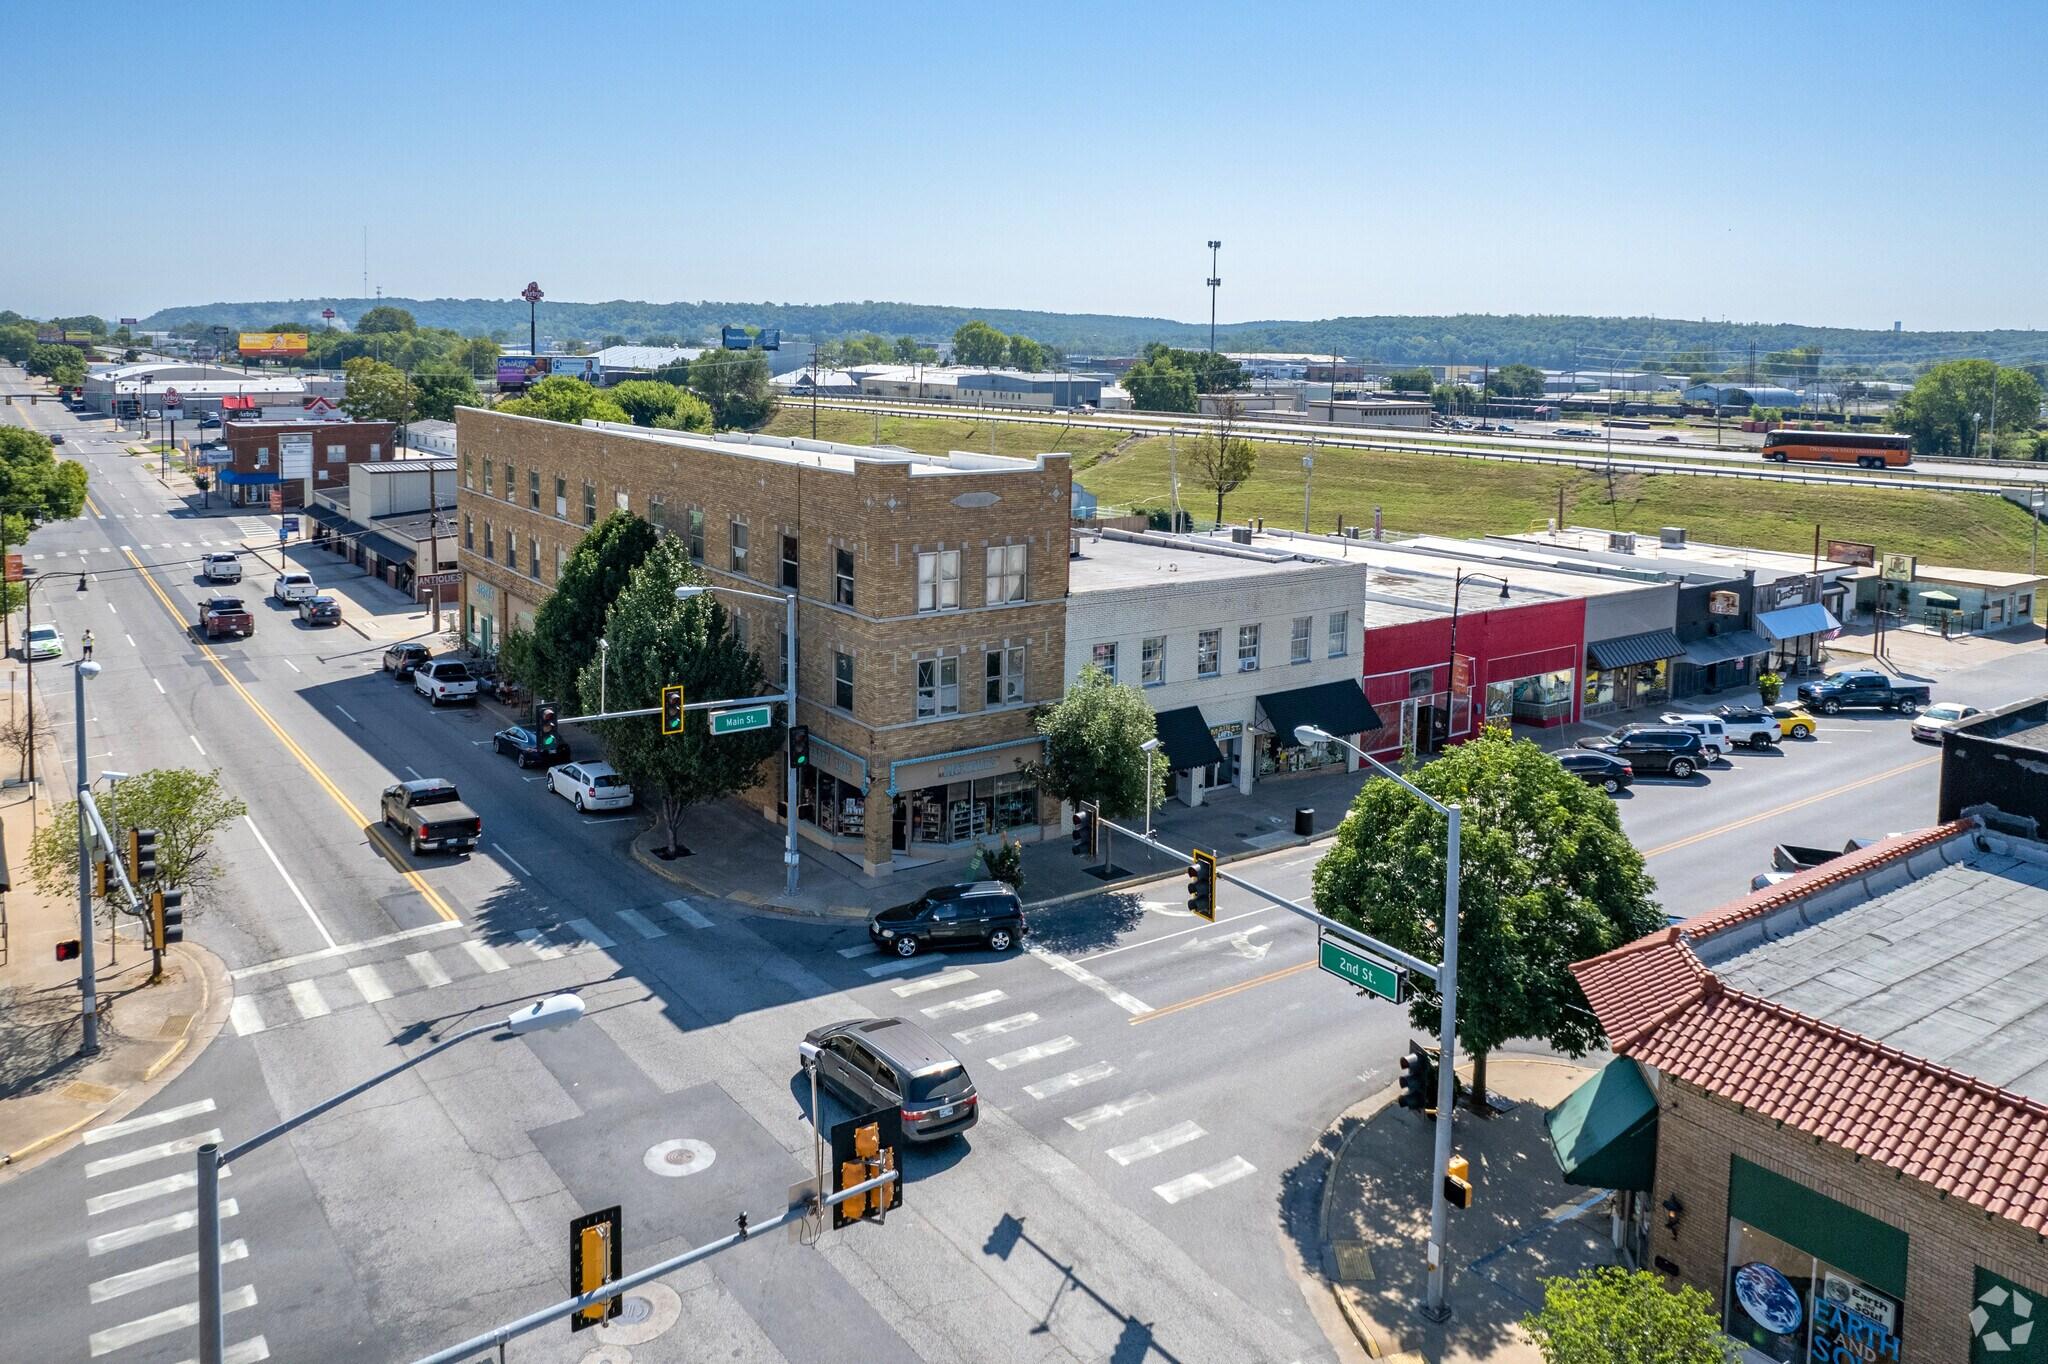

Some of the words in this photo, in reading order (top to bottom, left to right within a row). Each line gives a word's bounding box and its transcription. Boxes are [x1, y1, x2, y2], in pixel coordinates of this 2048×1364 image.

[162, 392, 183, 402] Arby's
[419, 573, 463, 585] ANTIQUES
[726, 716, 745, 727] Main
[746, 715, 757, 725] St.
[1339, 957, 1360, 976] 2nd
[1362, 968, 1377, 985] St.
[1852, 1287, 1889, 1313] Earth
[1854, 1302, 1884, 1323] Soul
[1813, 1295, 1902, 1363] EARTH
[1833, 1333, 1877, 1363] AND
